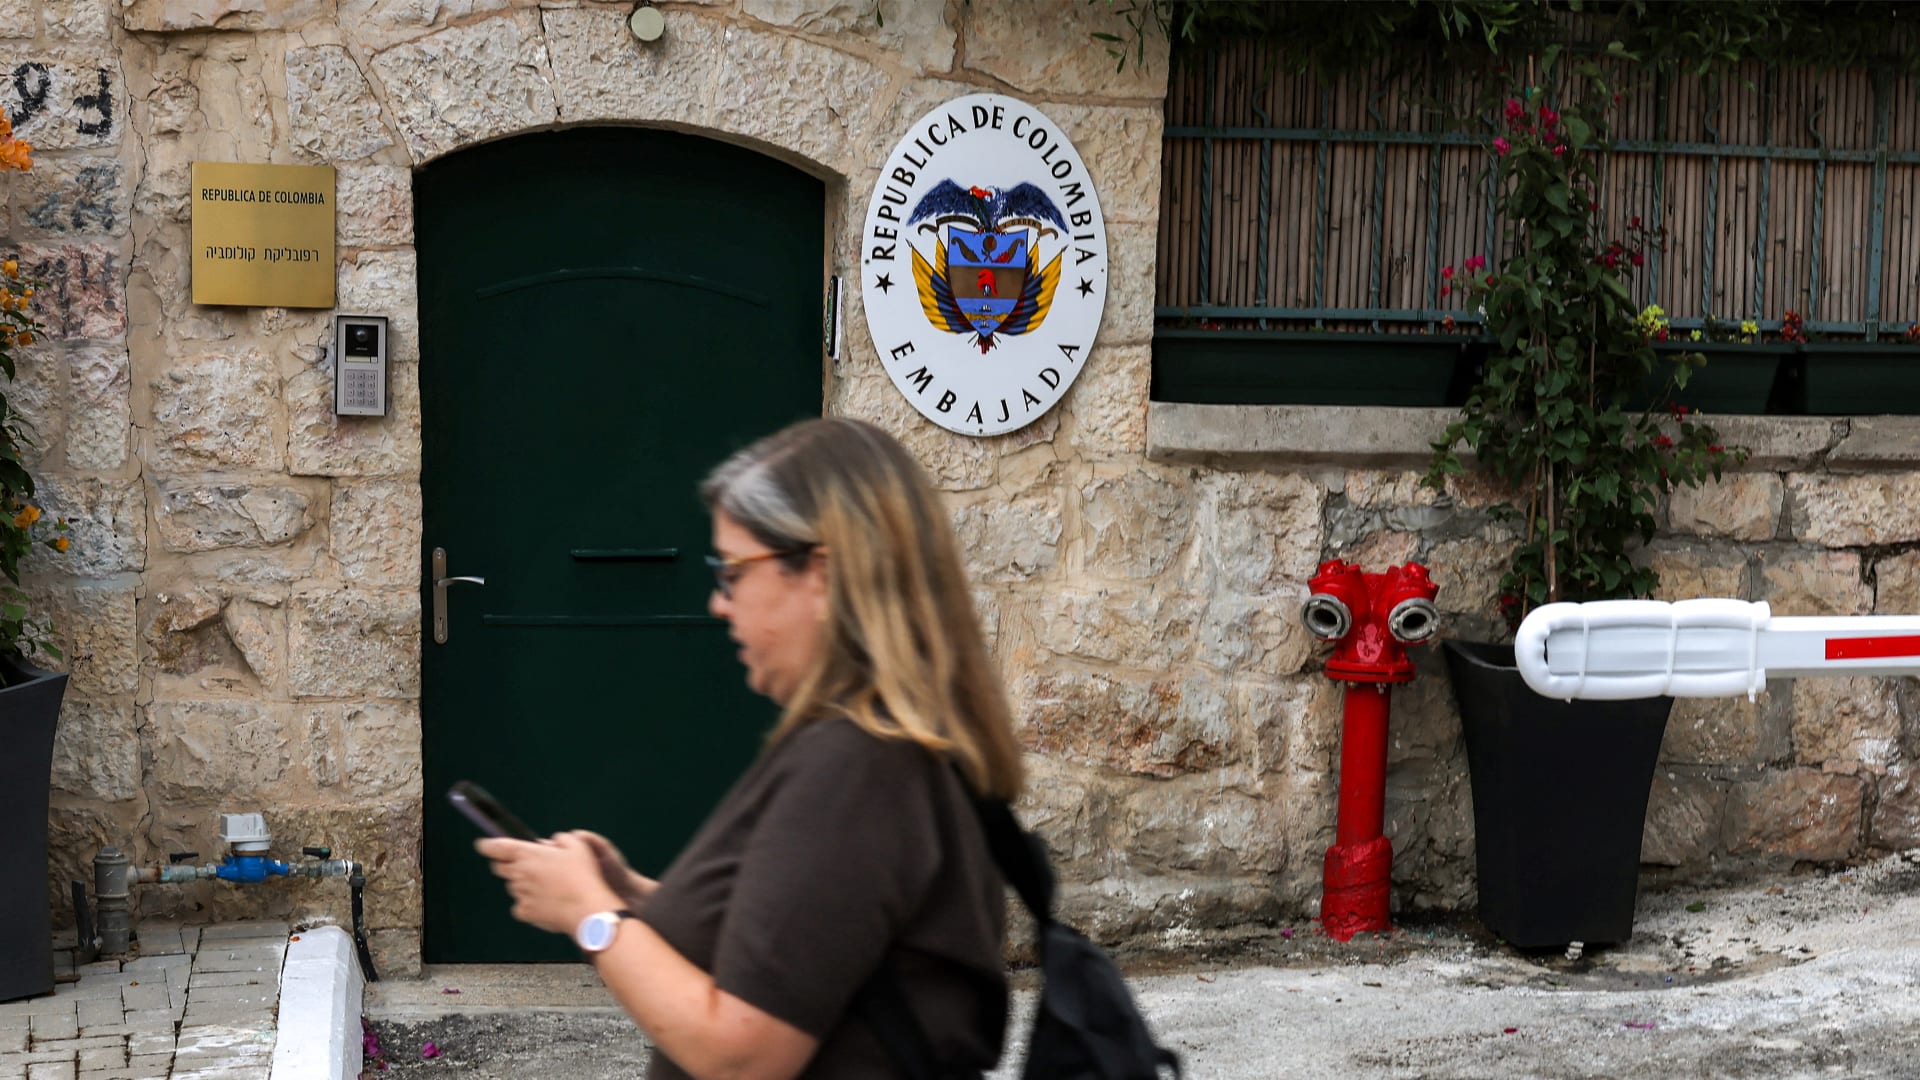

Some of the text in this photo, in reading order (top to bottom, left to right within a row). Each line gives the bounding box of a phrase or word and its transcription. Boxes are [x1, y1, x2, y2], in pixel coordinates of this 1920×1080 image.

[202, 188, 325, 205] REPUBLICA DE COLOMBIA
[871, 105, 1097, 266] REPUBLICA DE COLOMBIA
[206, 245, 319, 262] רפובליקת קולומביה
[890, 341, 1080, 425] EMBAJADA
